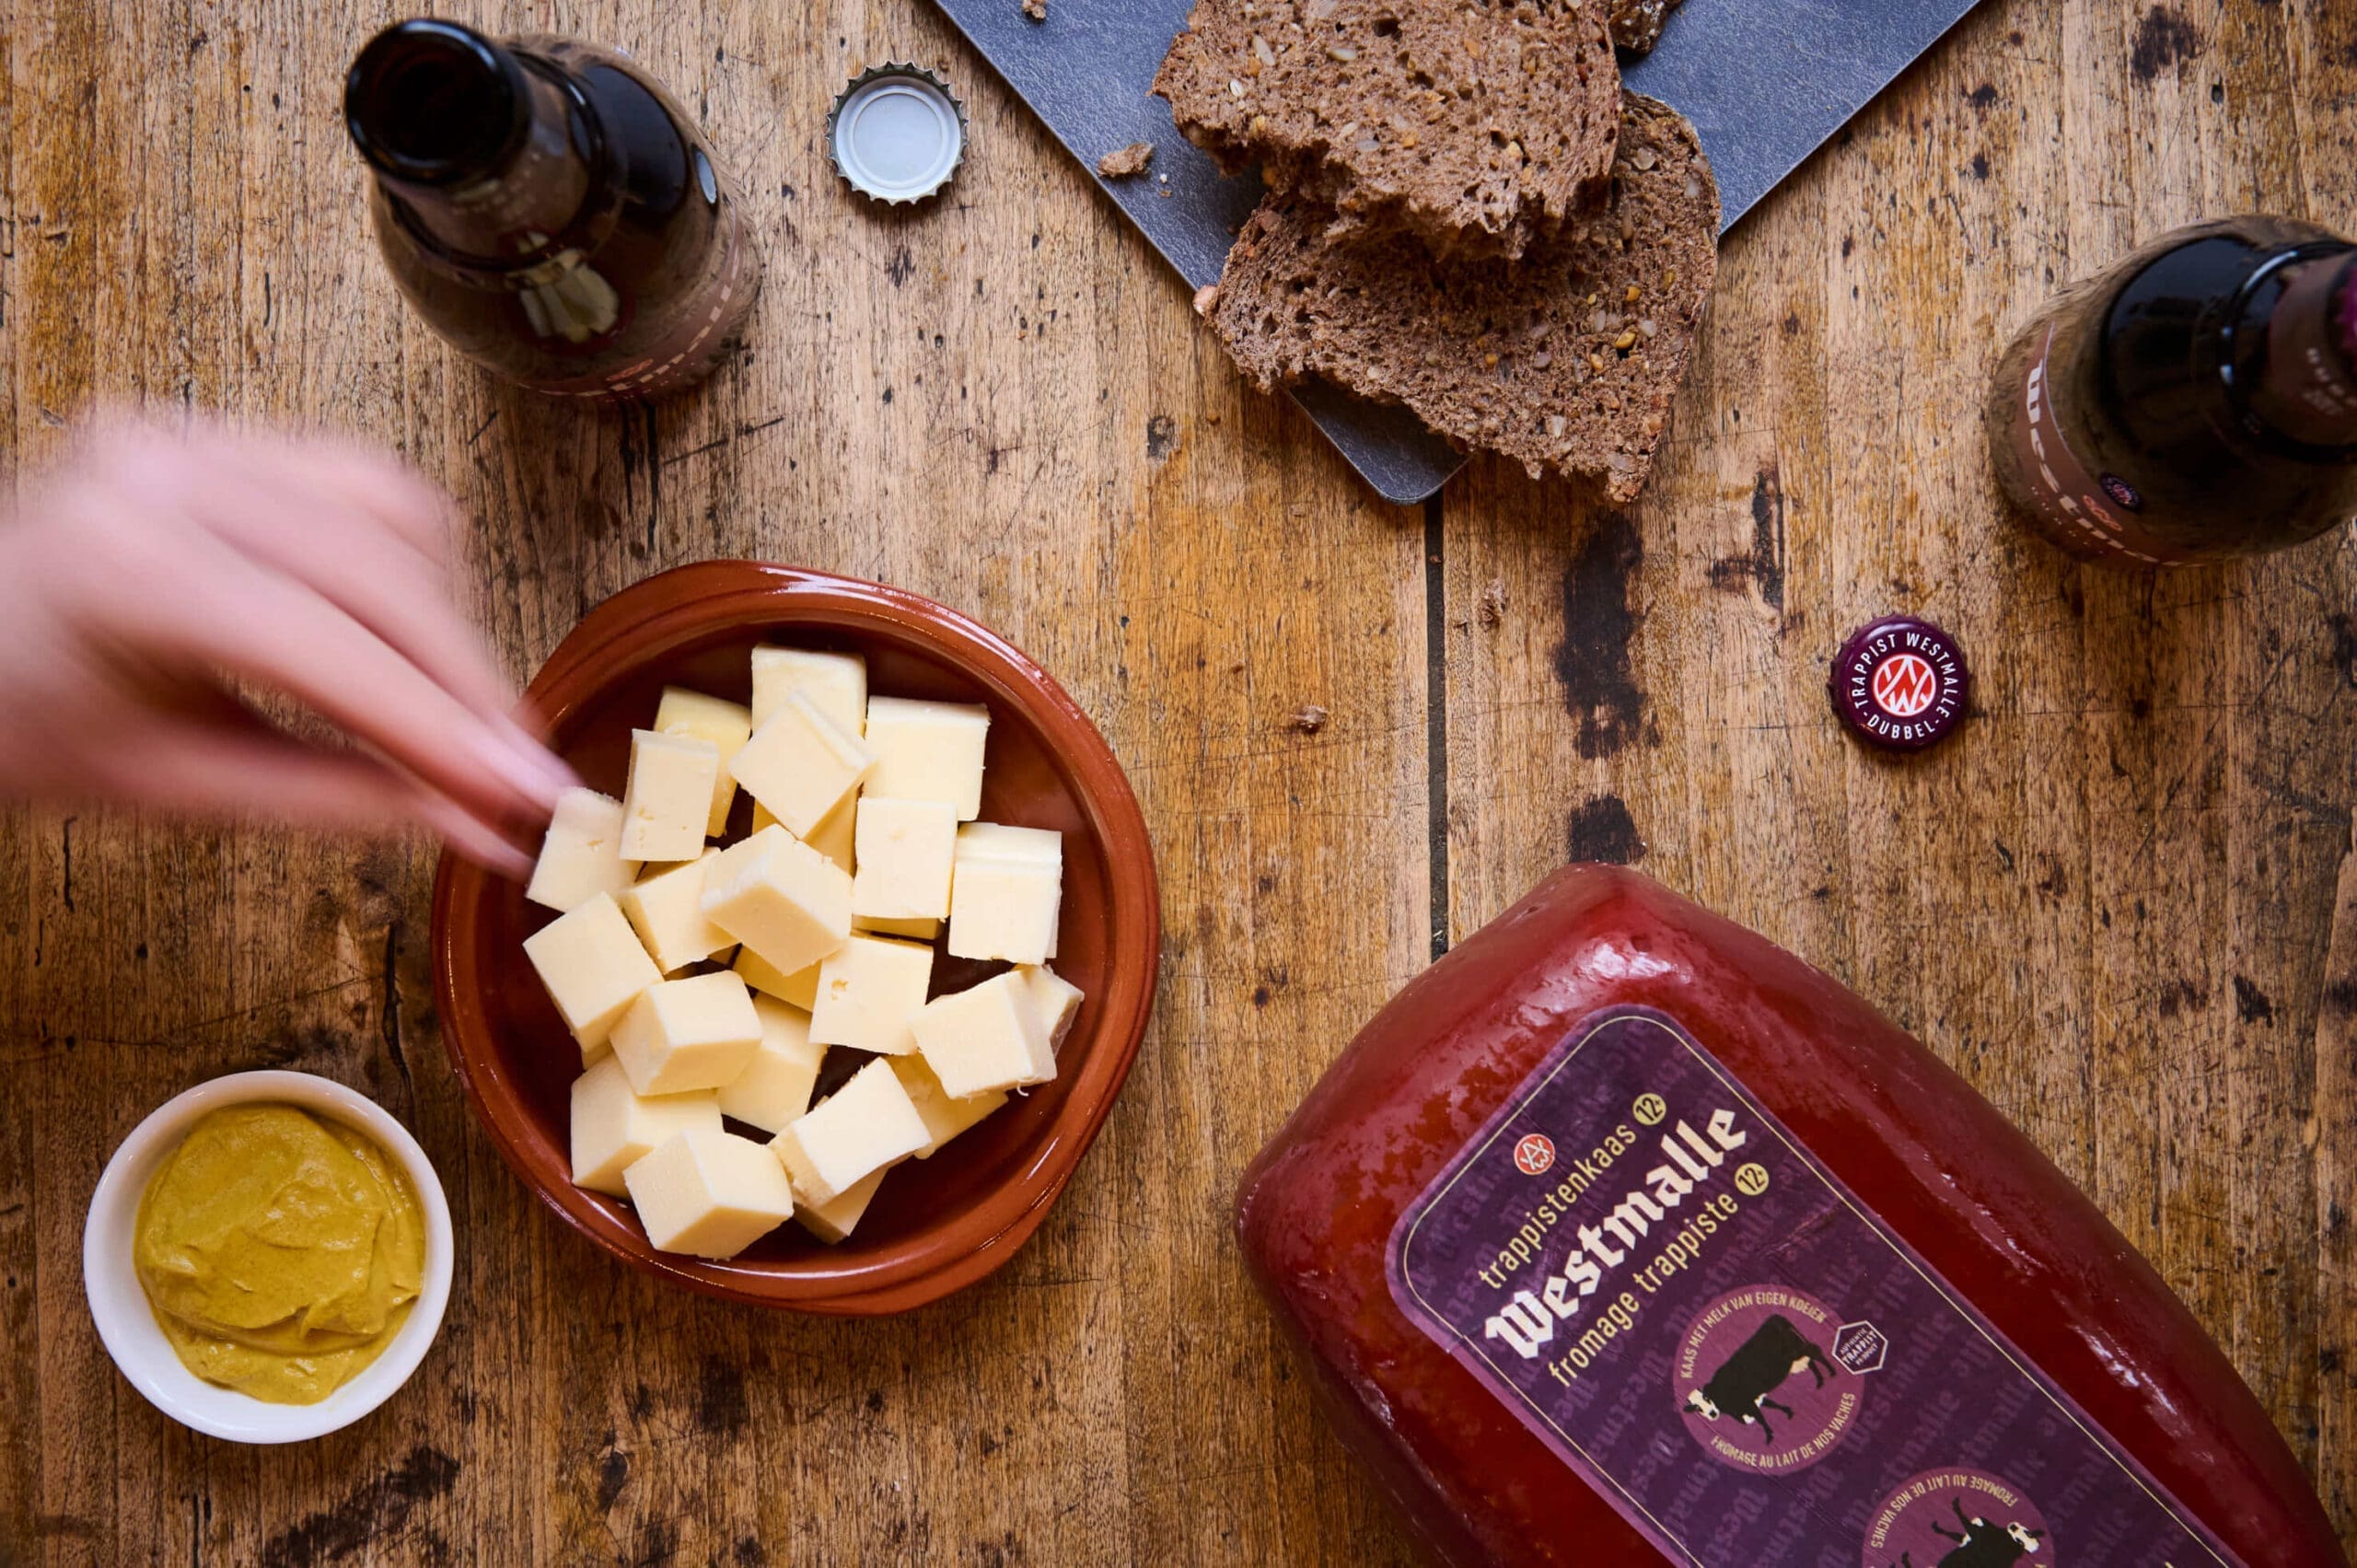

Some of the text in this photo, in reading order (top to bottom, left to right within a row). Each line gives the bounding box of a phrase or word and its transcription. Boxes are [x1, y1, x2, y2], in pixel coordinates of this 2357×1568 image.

[1852, 632, 1958, 718] TRAPPIST WESTMALLE
[1867, 714, 1935, 740] DUBBEL
[1478, 1124, 1637, 1289] trappistenkaas
[1485, 1109, 1747, 1360] Westmalle
[1549, 1292, 1640, 1388] fromage
[1632, 1193, 1739, 1294] trappiste
[1680, 1348, 1698, 1378] KAAS
[1689, 1323, 1708, 1348] MET
[1703, 1303, 1733, 1329] MELK
[1729, 1294, 1753, 1310] VAN
[1755, 1292, 1788, 1307] EIGEN
[1841, 1330, 1877, 1365] TRAPPIST
[1711, 1392, 1856, 1468] FROMAGE AU LAIT DE NOS VACHES
[1871, 1474, 2019, 1549] FROMAGE AU LAIT DE NOS VACHES
